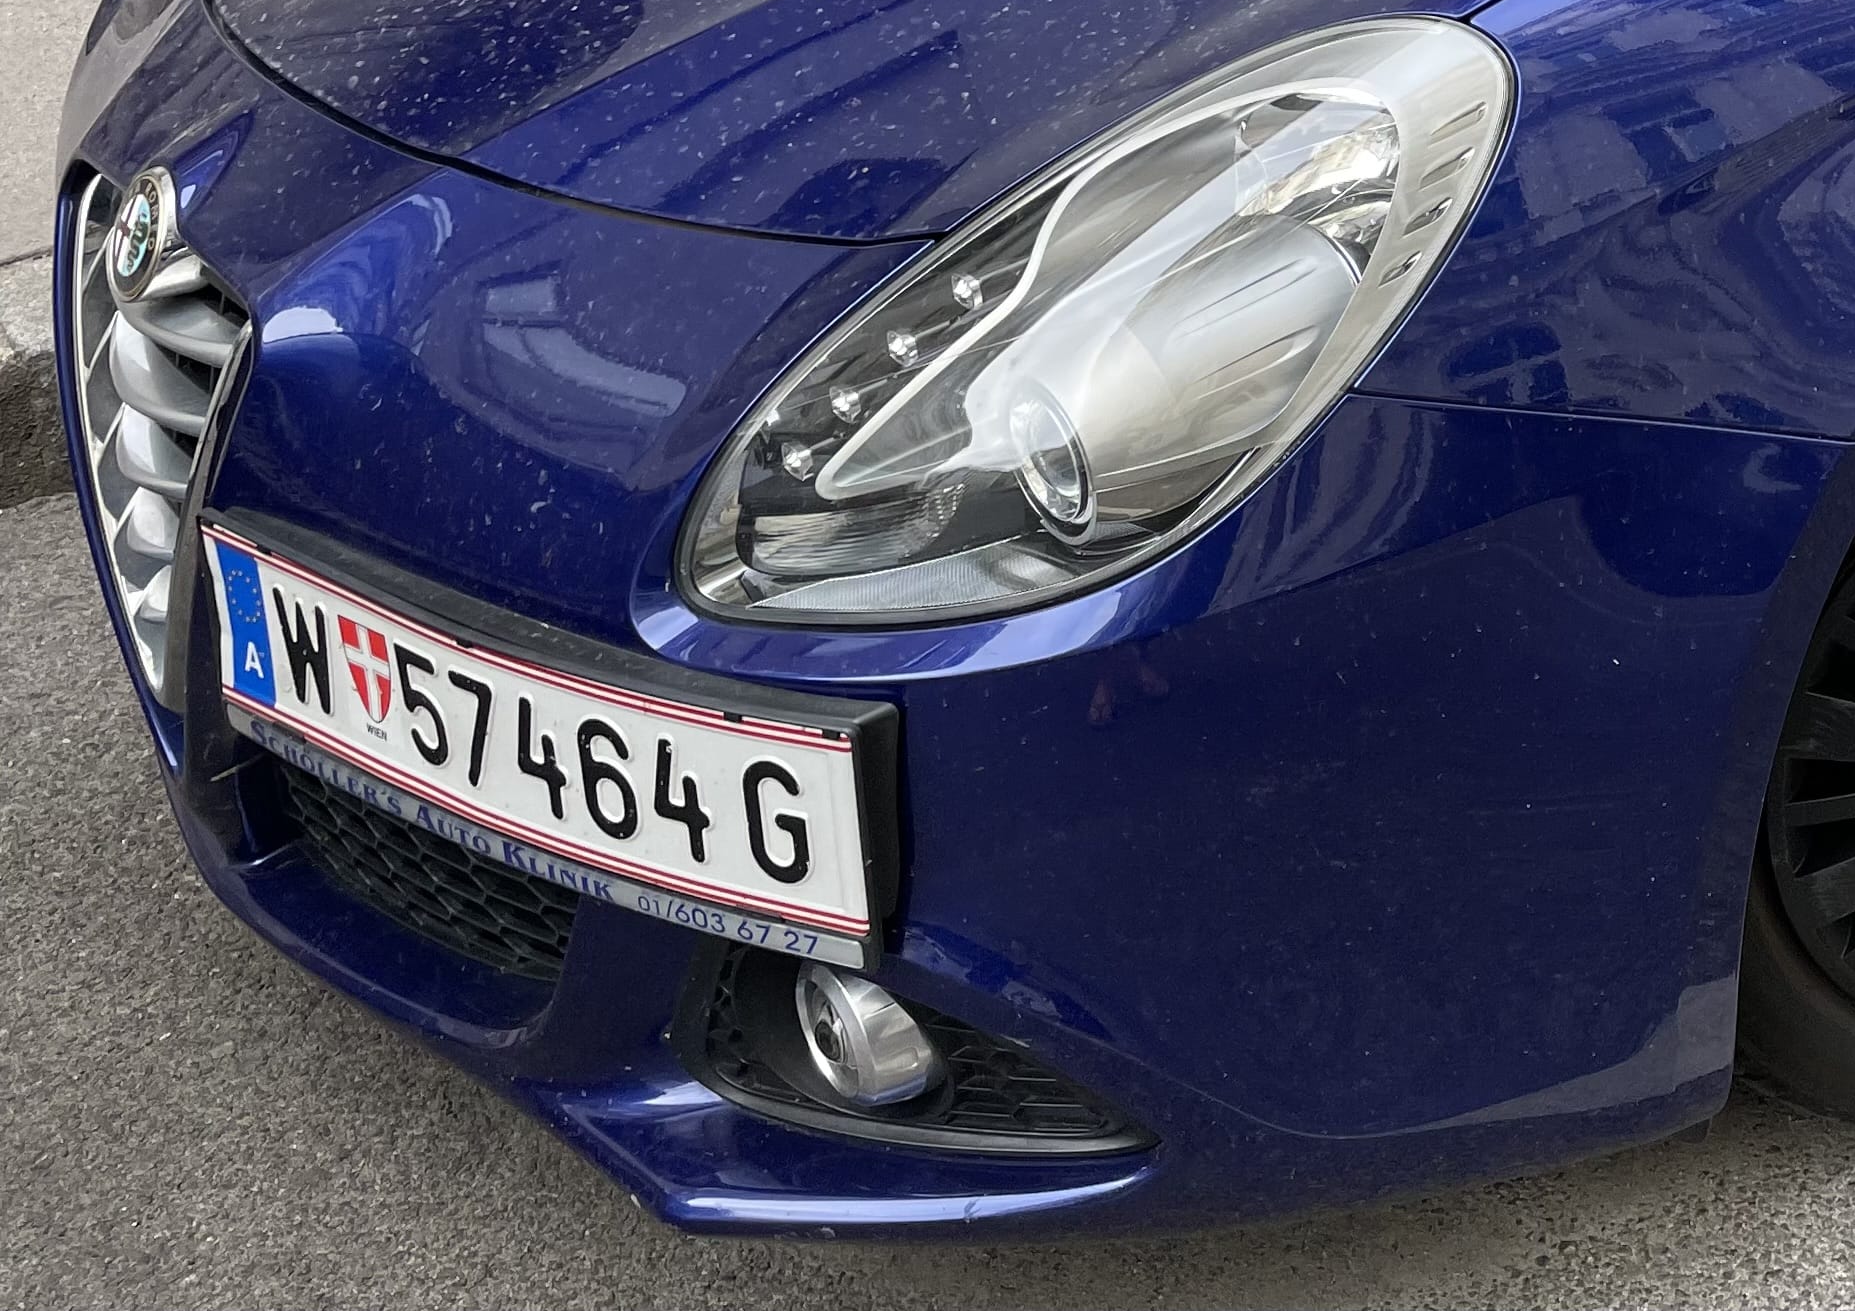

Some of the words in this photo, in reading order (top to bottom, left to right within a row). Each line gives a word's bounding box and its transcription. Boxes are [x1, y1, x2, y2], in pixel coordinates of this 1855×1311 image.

[244, 641, 265, 679] A
[272, 586, 332, 716] W
[393, 641, 711, 863] 57464
[742, 760, 809, 884] G
[366, 722, 388, 742] WIEN
[637, 895, 727, 934] 01/603
[737, 919, 772, 945] 67
[783, 930, 819, 955] 27
